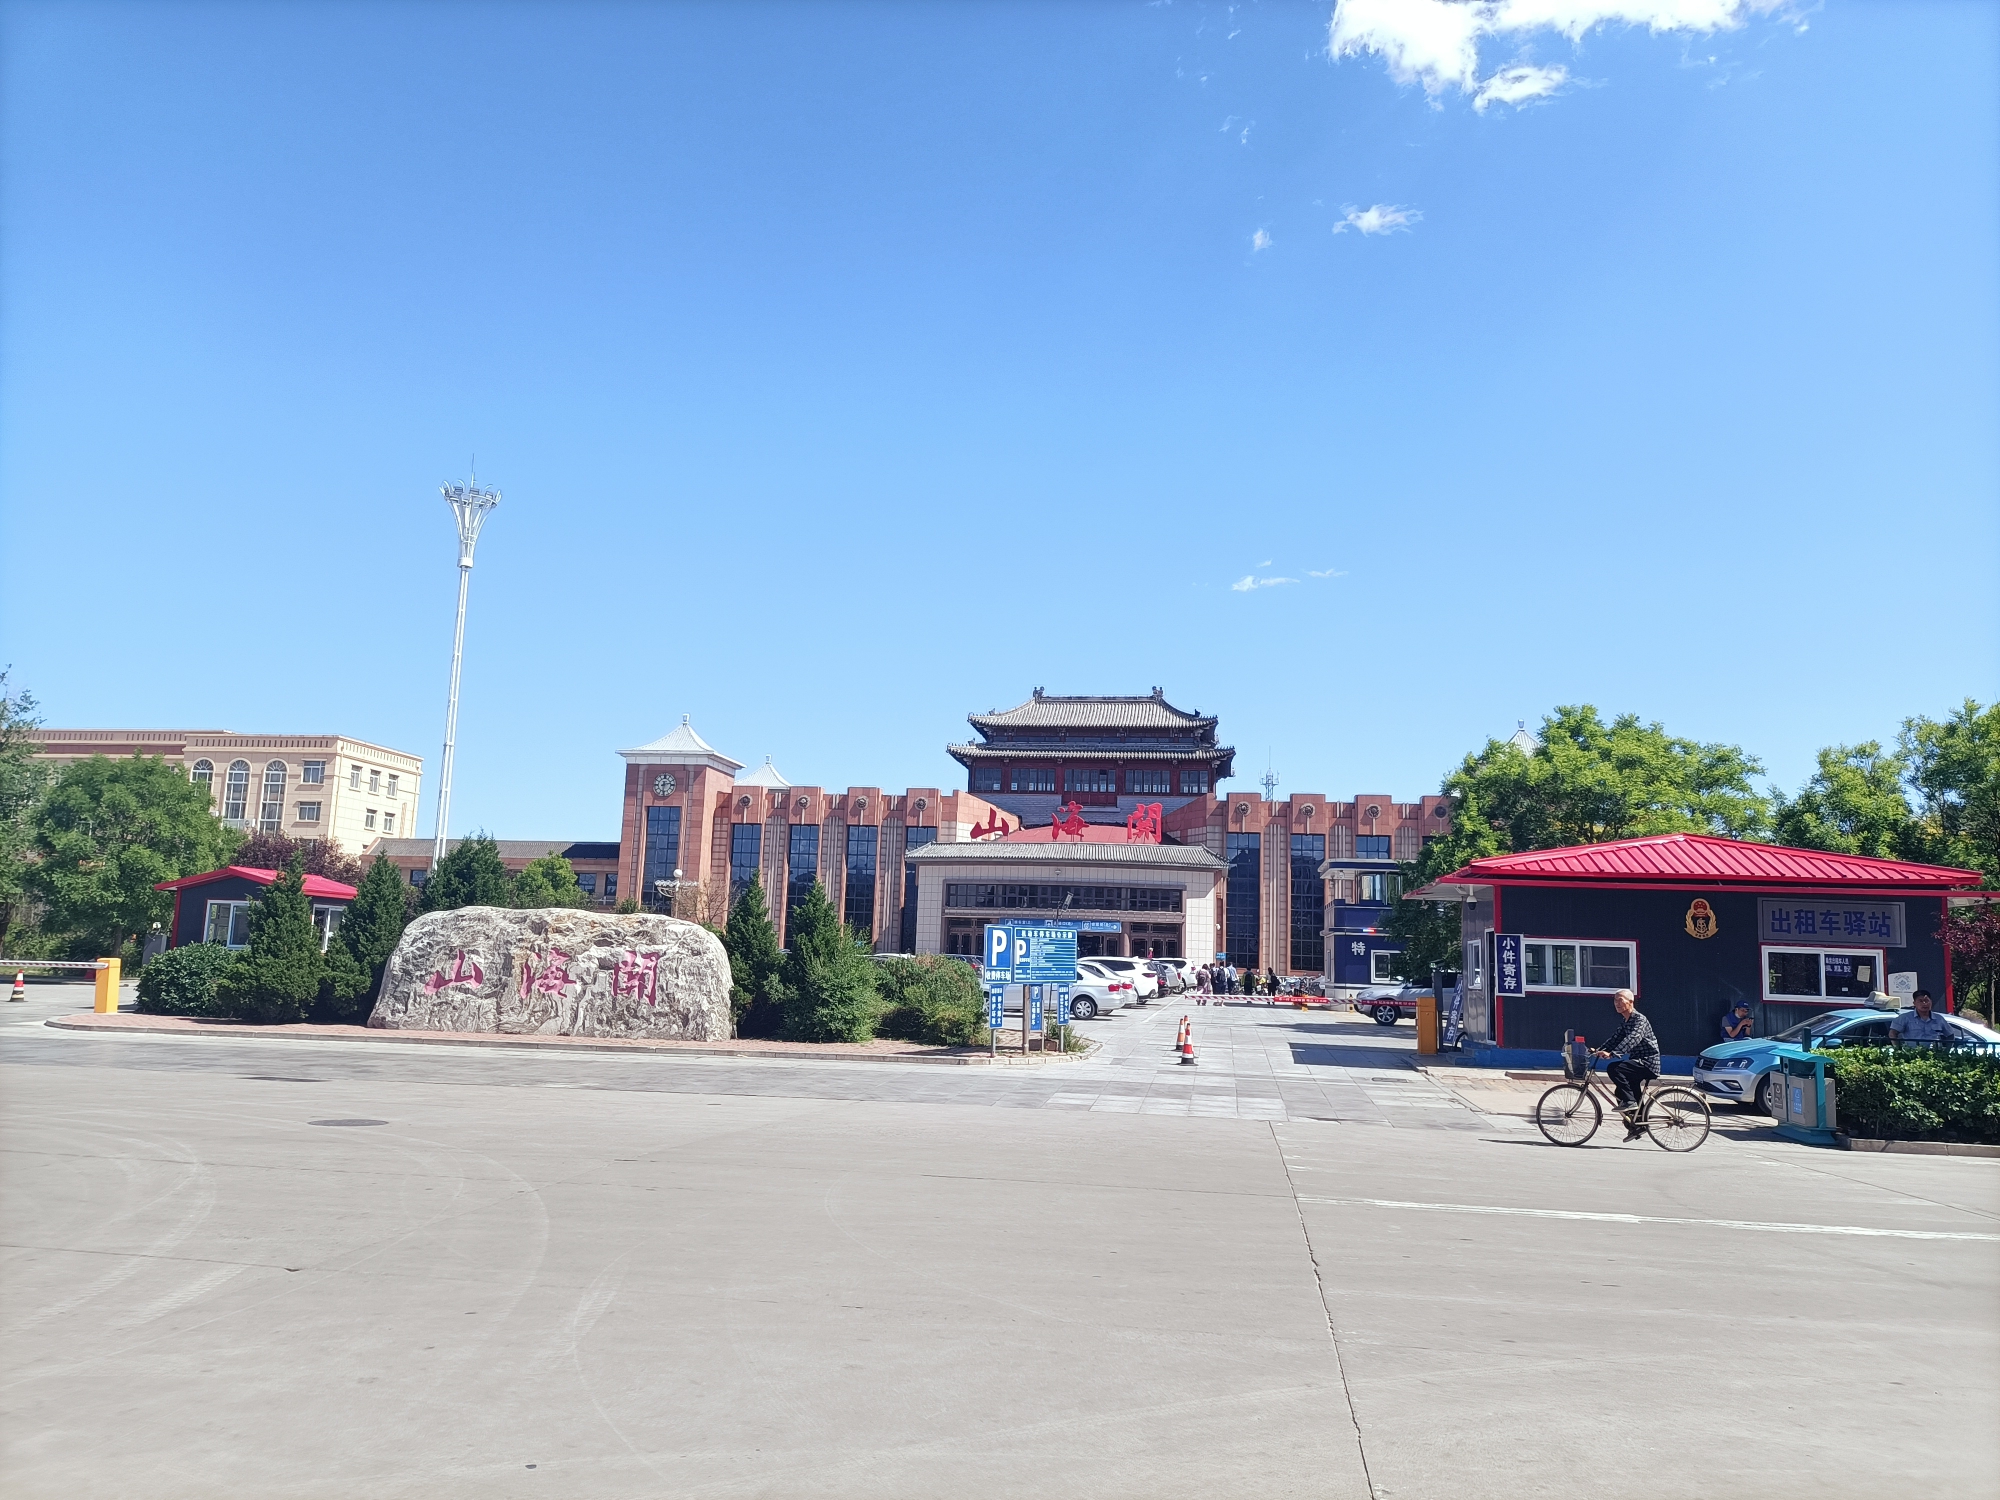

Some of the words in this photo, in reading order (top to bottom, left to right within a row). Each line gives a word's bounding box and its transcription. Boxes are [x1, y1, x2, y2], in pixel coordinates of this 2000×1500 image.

[1770, 908, 1891, 938] 出租车驿站
[991, 929, 1008, 967] P
[1015, 939, 1027, 965] P
[1351, 941, 1366, 956] 特
[1502, 937, 1518, 990] 小件寄存
